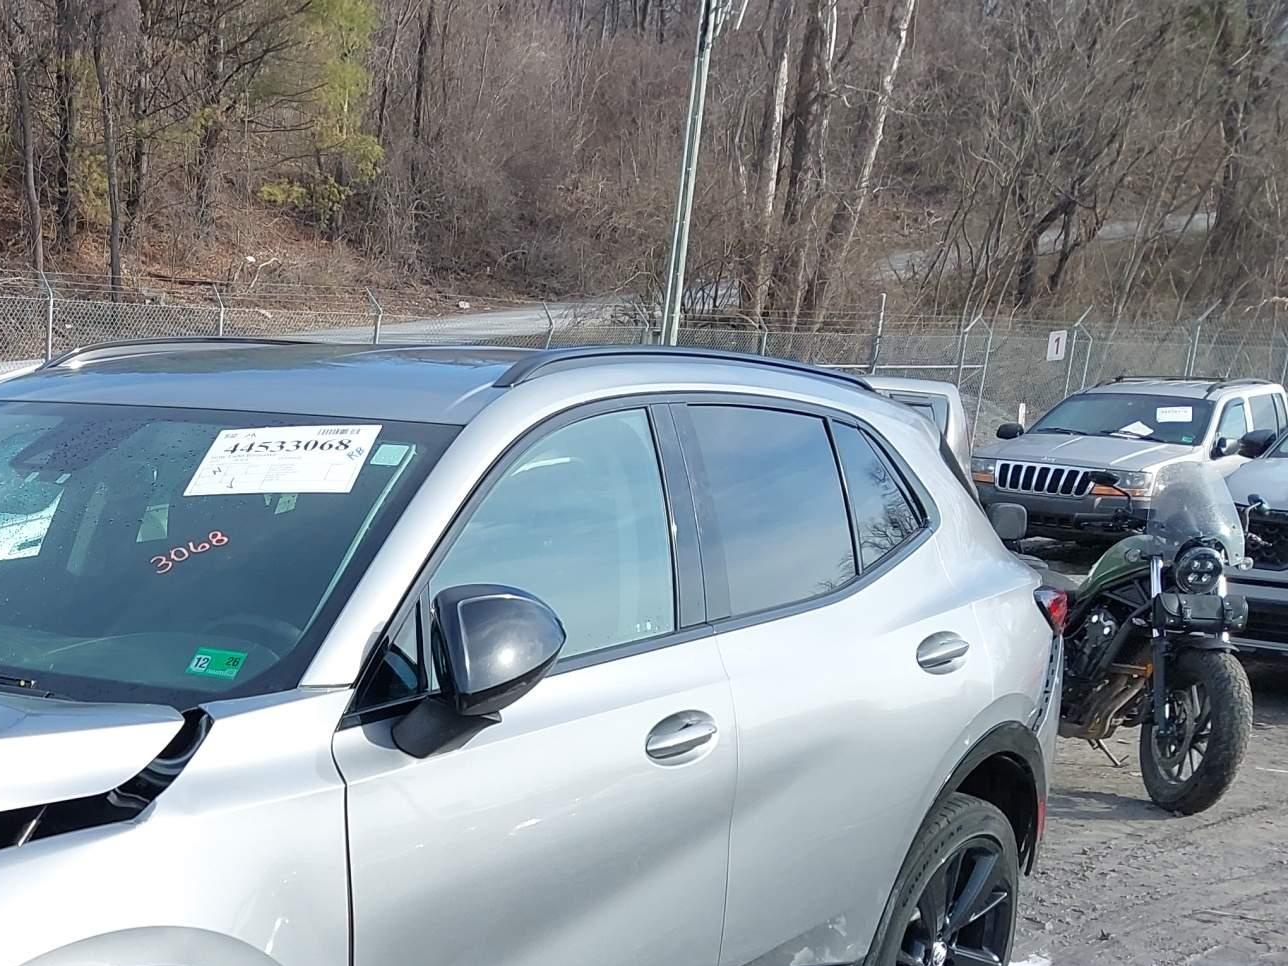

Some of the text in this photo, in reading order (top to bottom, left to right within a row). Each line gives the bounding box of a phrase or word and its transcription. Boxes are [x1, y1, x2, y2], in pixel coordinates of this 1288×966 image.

[1055, 336, 1061, 355] 1
[224, 438, 352, 454] 44533068
[150, 530, 230, 574] 3068
[194, 656, 241, 669] 12 26
